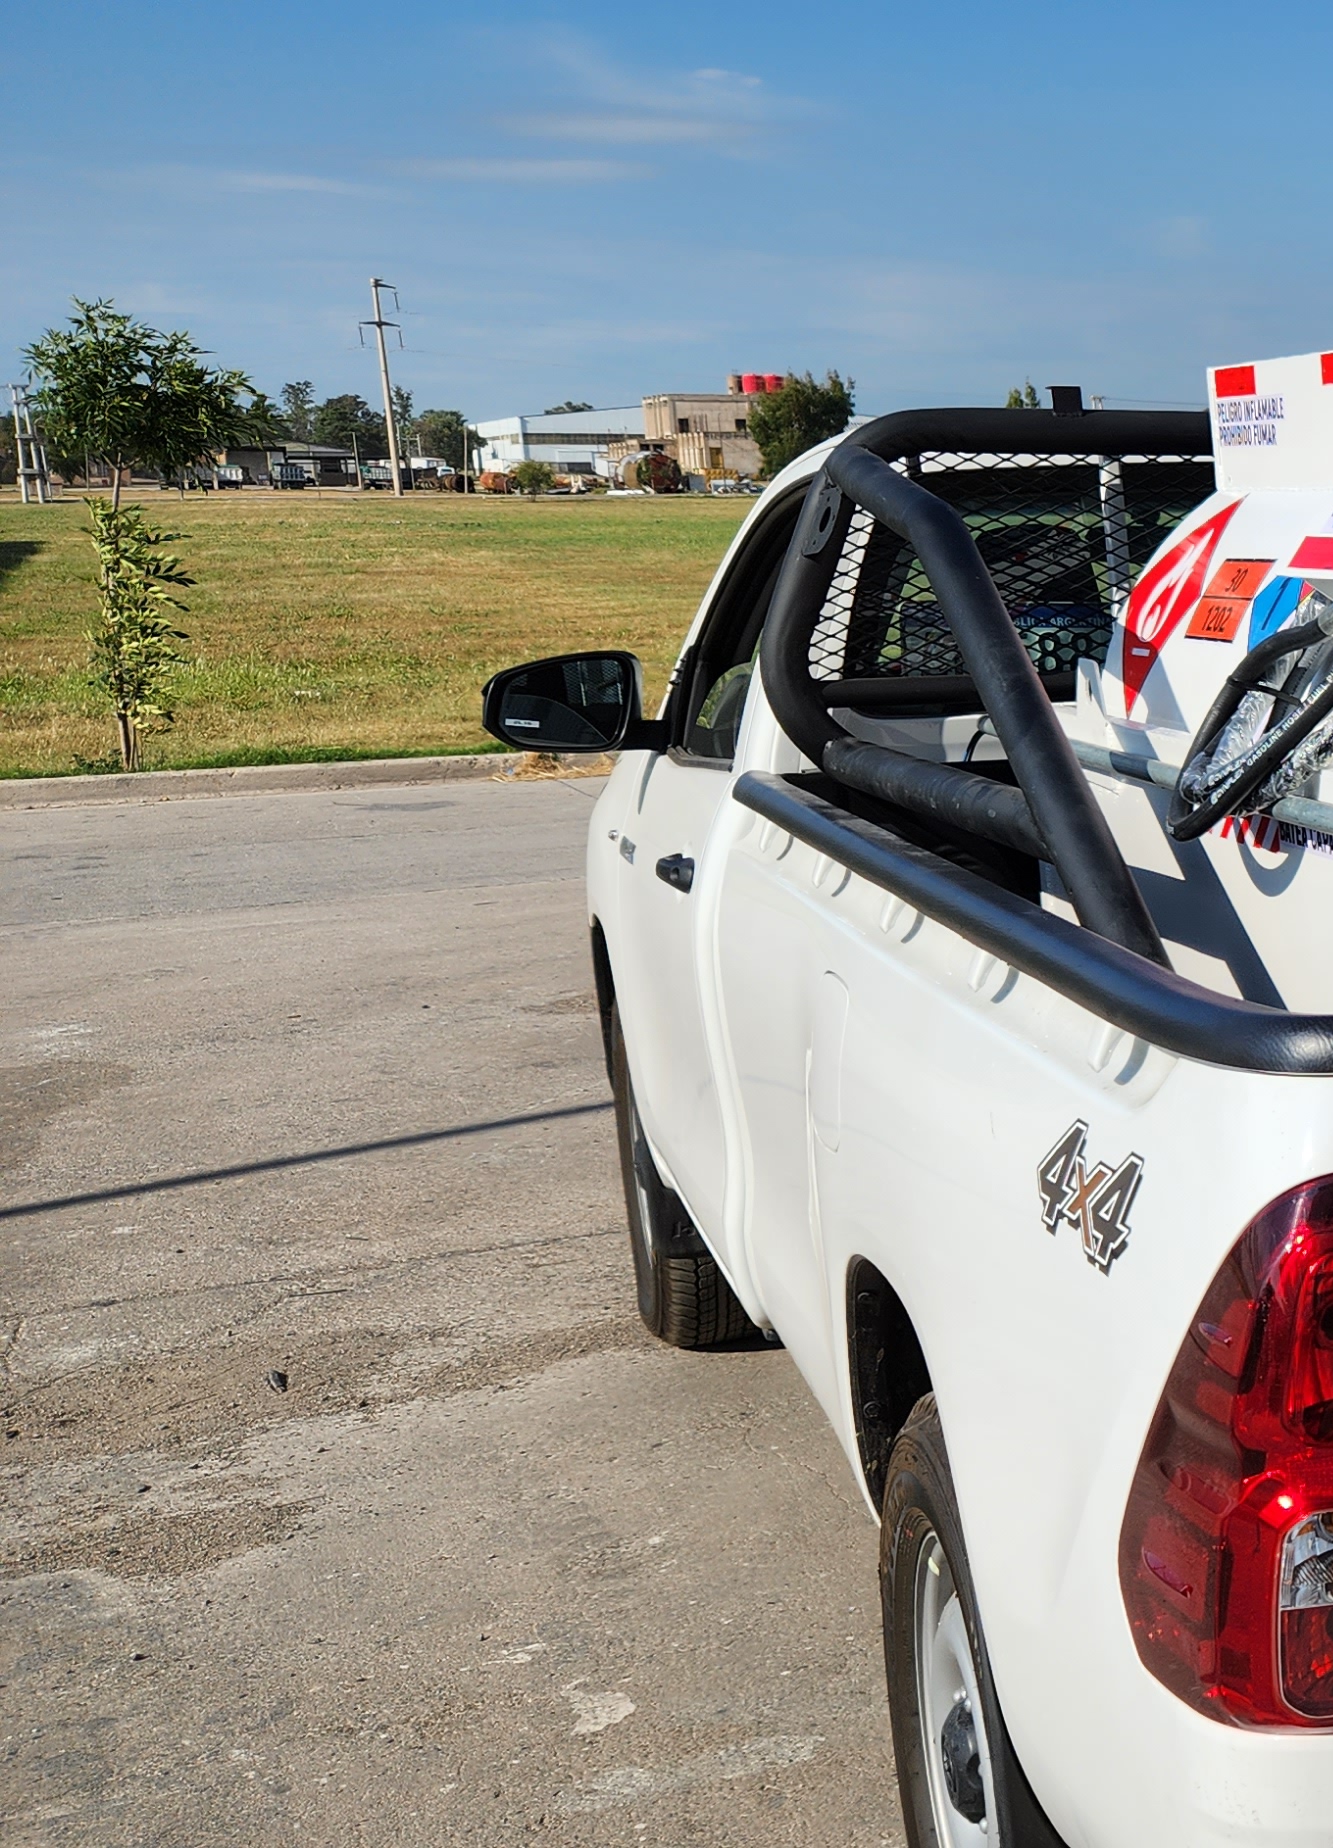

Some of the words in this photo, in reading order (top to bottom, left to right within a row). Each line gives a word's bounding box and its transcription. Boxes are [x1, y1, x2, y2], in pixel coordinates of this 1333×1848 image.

[1243, 397, 1285, 421] INFLAMABLE
[1253, 424, 1277, 445] FUMAR
[1225, 568, 1249, 593] 30
[1050, 614, 1111, 627] ARGTINA
[1201, 604, 1233, 632] 1202
[1246, 730, 1283, 766] GASOLINE
[1282, 706, 1303, 731] HOSE
[1308, 682, 1328, 703] FUEL
